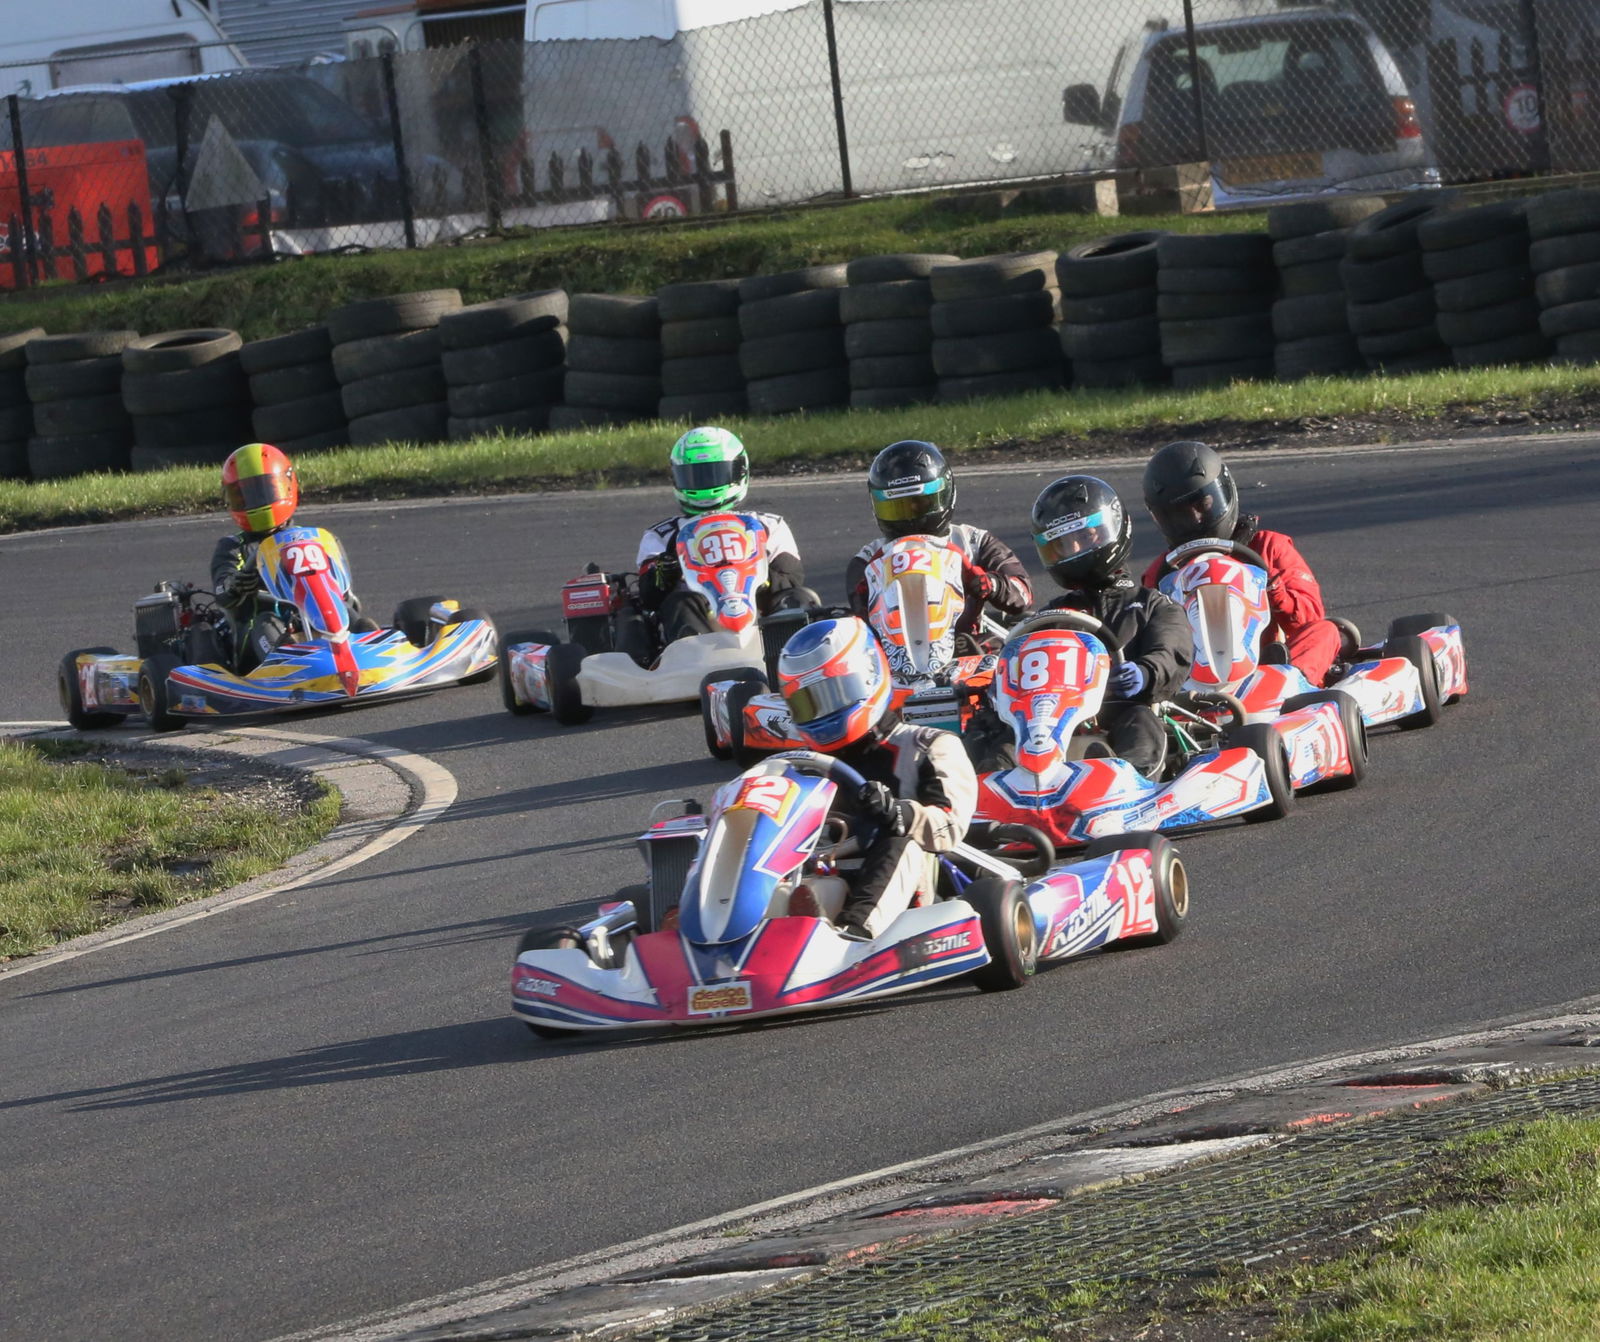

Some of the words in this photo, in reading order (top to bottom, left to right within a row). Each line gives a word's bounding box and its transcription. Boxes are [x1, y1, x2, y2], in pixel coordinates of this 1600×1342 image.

[286, 544, 328, 575] 29
[702, 533, 744, 564] 35
[892, 549, 932, 574] 92
[1183, 559, 1241, 592] 27
[1020, 647, 1079, 690] 81
[1123, 793, 1174, 825] SPR
[1115, 857, 1157, 929] 12
